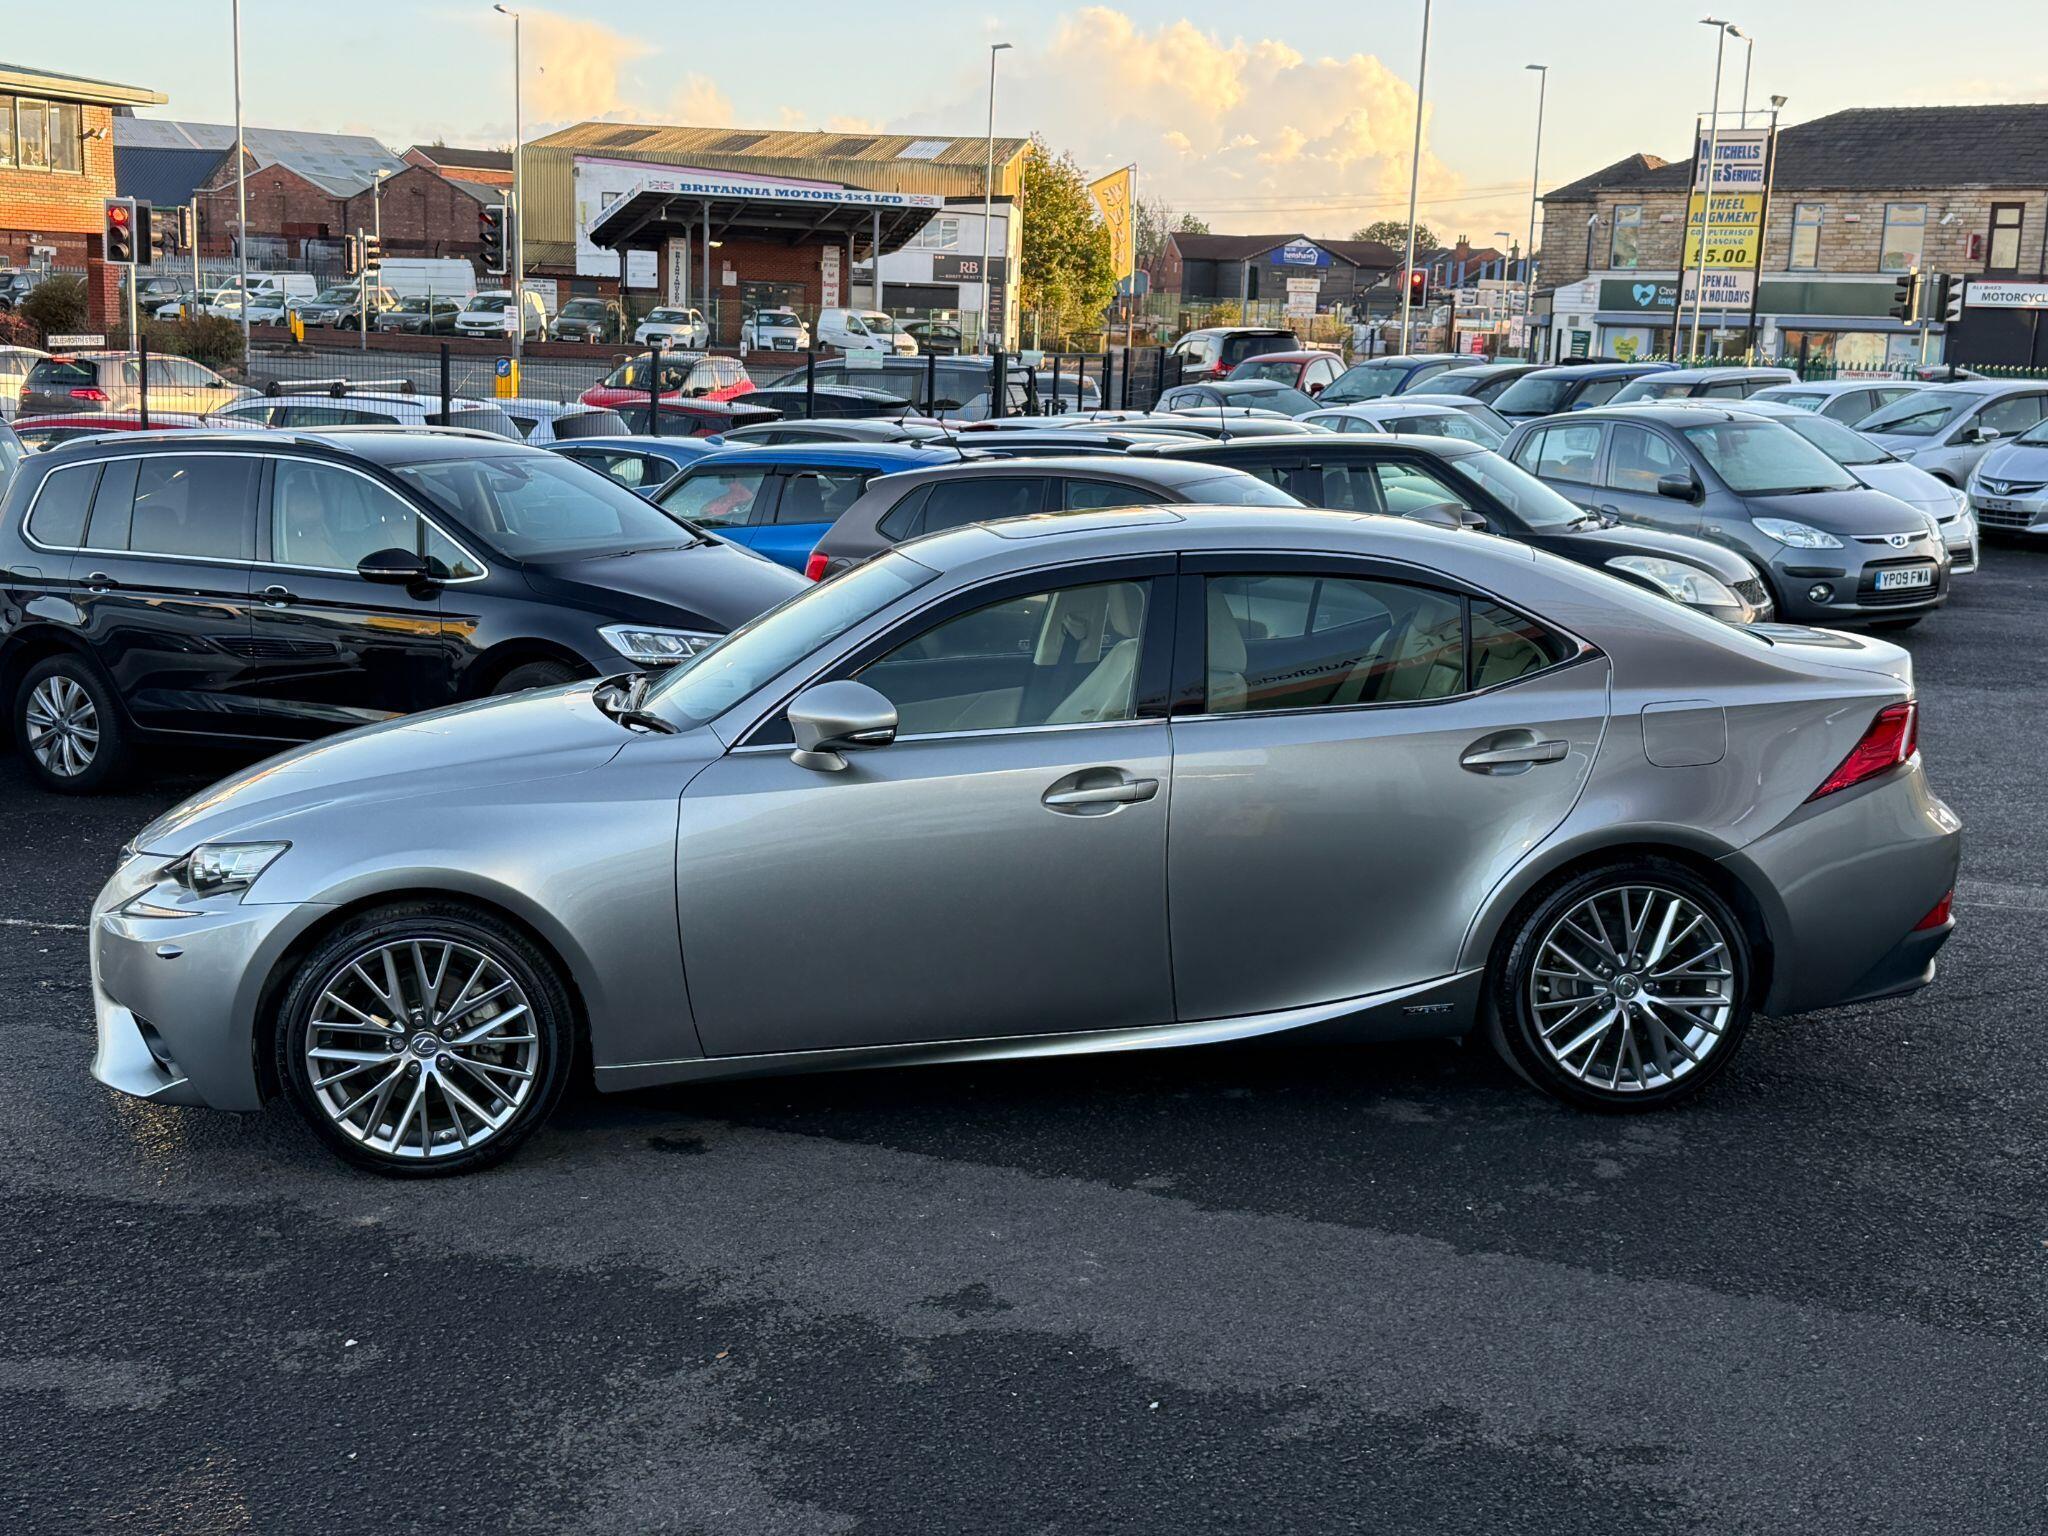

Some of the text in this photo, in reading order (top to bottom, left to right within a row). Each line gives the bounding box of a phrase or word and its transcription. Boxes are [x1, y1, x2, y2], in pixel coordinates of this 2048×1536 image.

[1700, 163, 1762, 182] TRE SERVICE
[680, 183, 772, 197] BRITANNIA
[774, 188, 843, 201] MOTORS
[1690, 211, 1758, 223] ALGNMENT
[959, 261, 979, 274] RB
[1722, 275, 1737, 288] ALL
[1684, 289, 1750, 303] BAK HOLIDAYS
[1883, 569, 1929, 586] YP09 FWA
